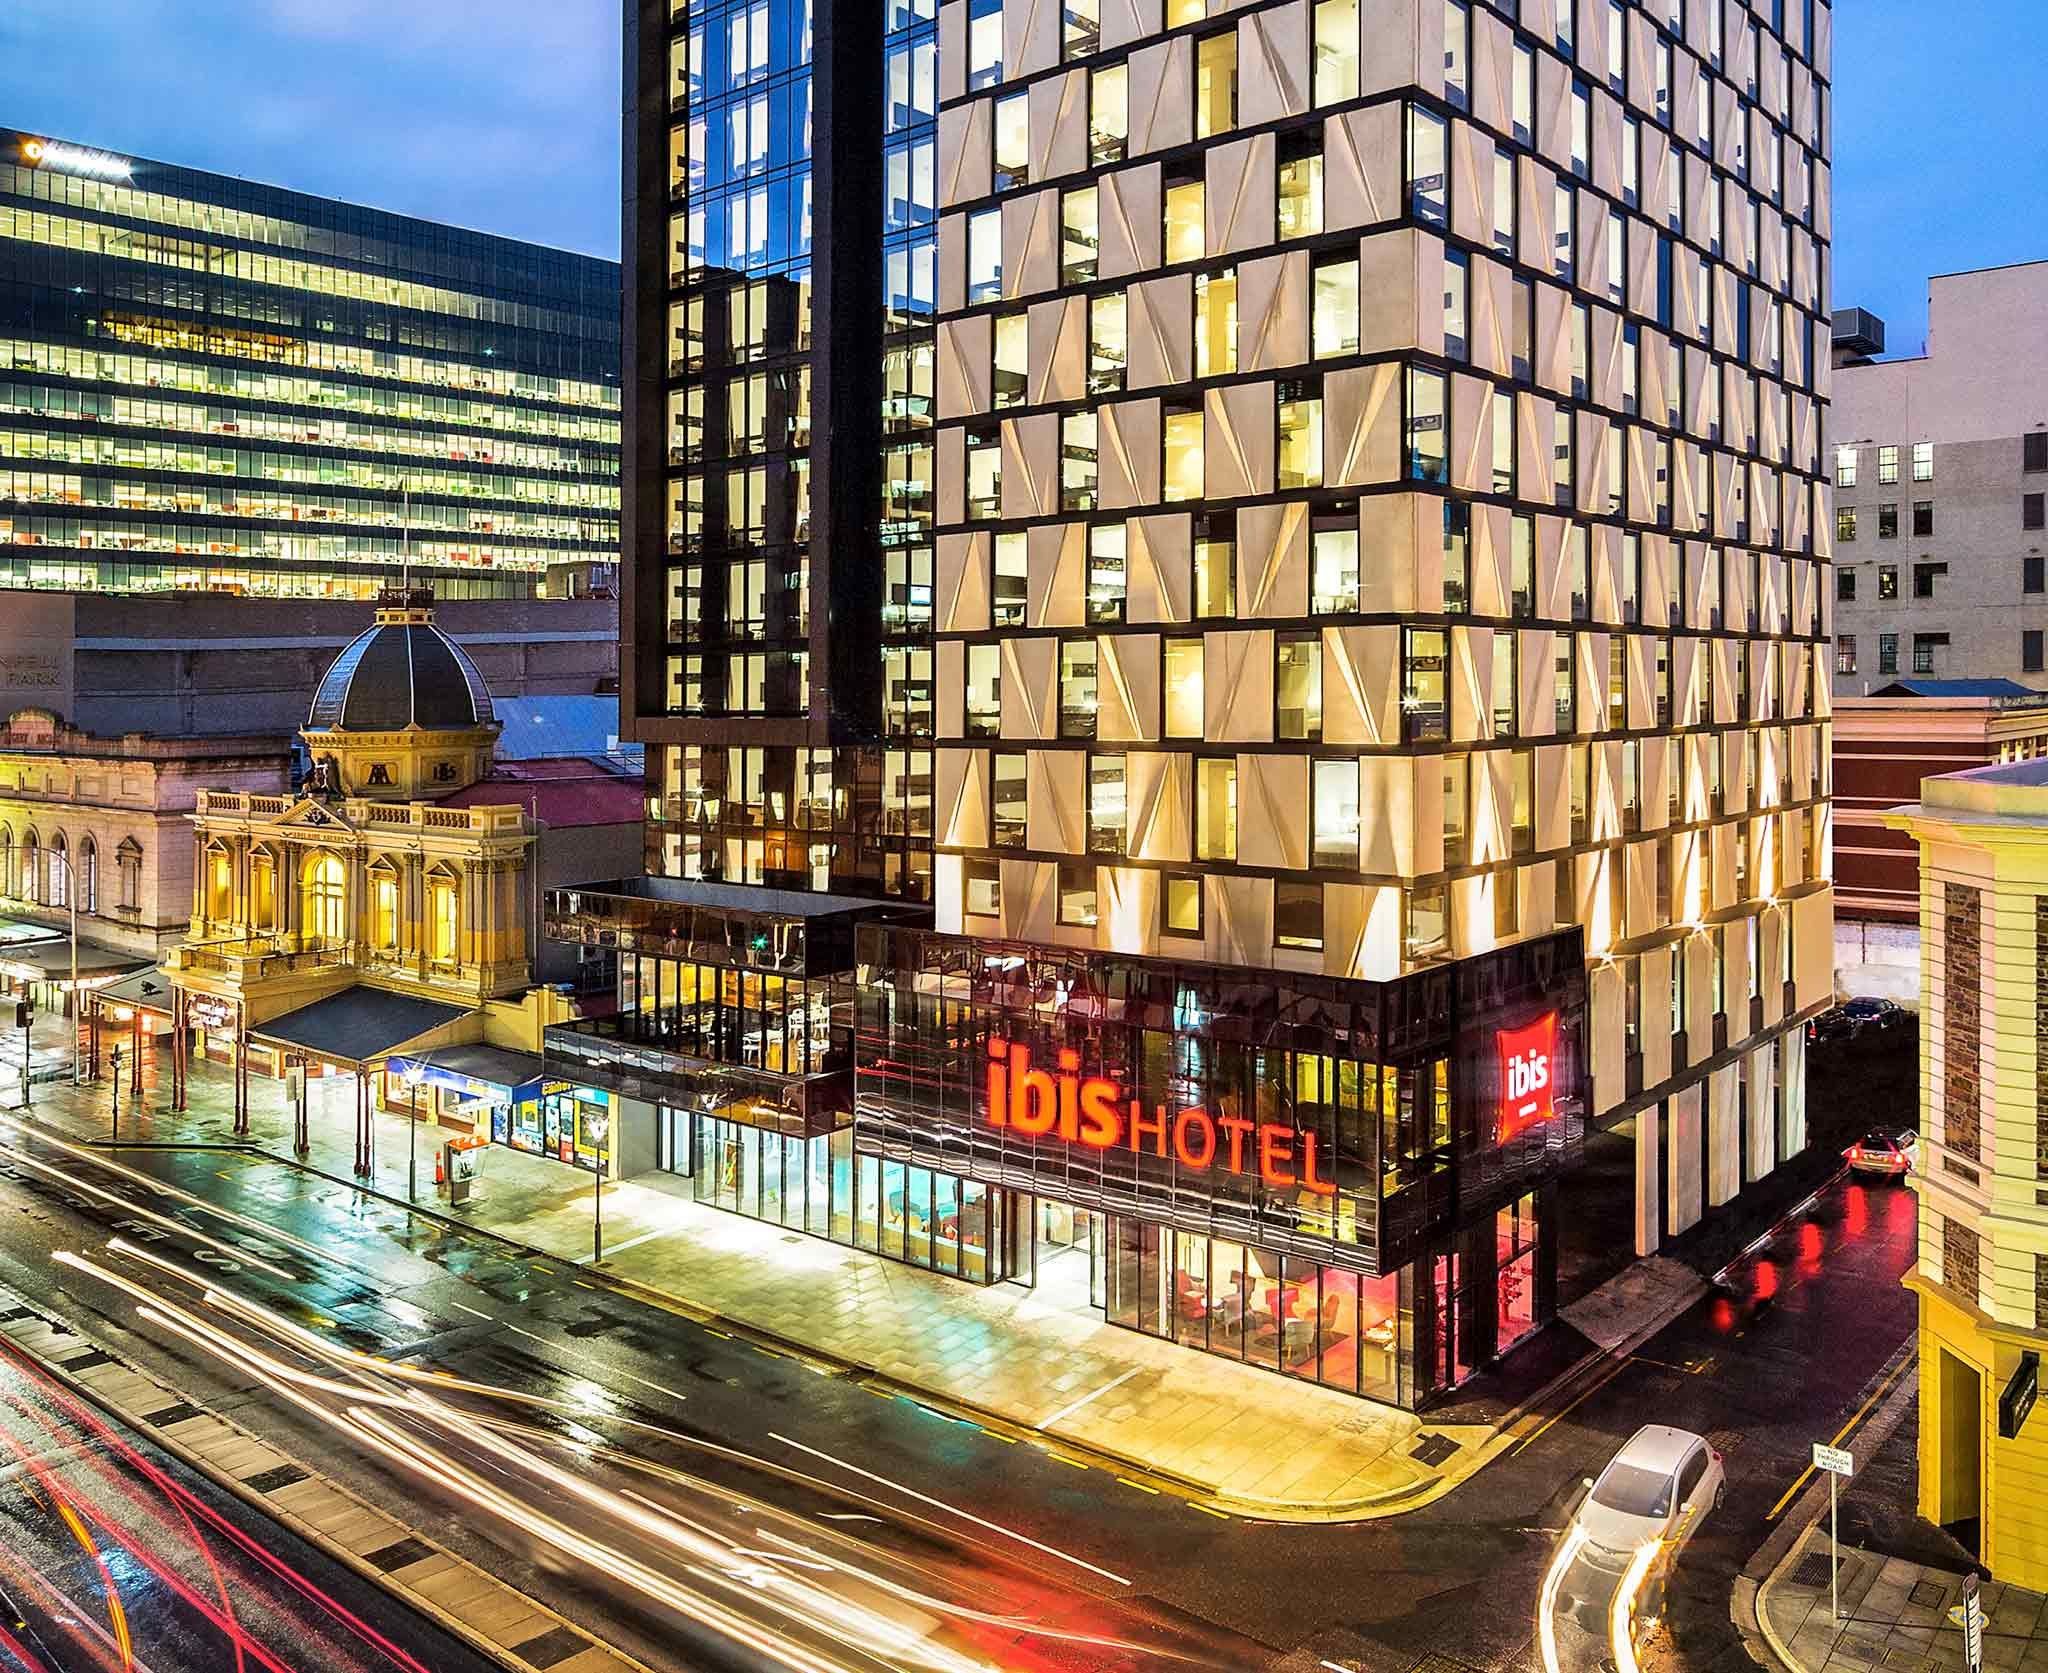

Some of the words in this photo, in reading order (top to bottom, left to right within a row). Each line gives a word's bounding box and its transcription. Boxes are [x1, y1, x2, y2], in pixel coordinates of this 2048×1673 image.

[987, 1038, 1121, 1148] ibis
[1130, 1100, 1338, 1194] HOTEL
[1507, 1048, 1548, 1101] ibis
